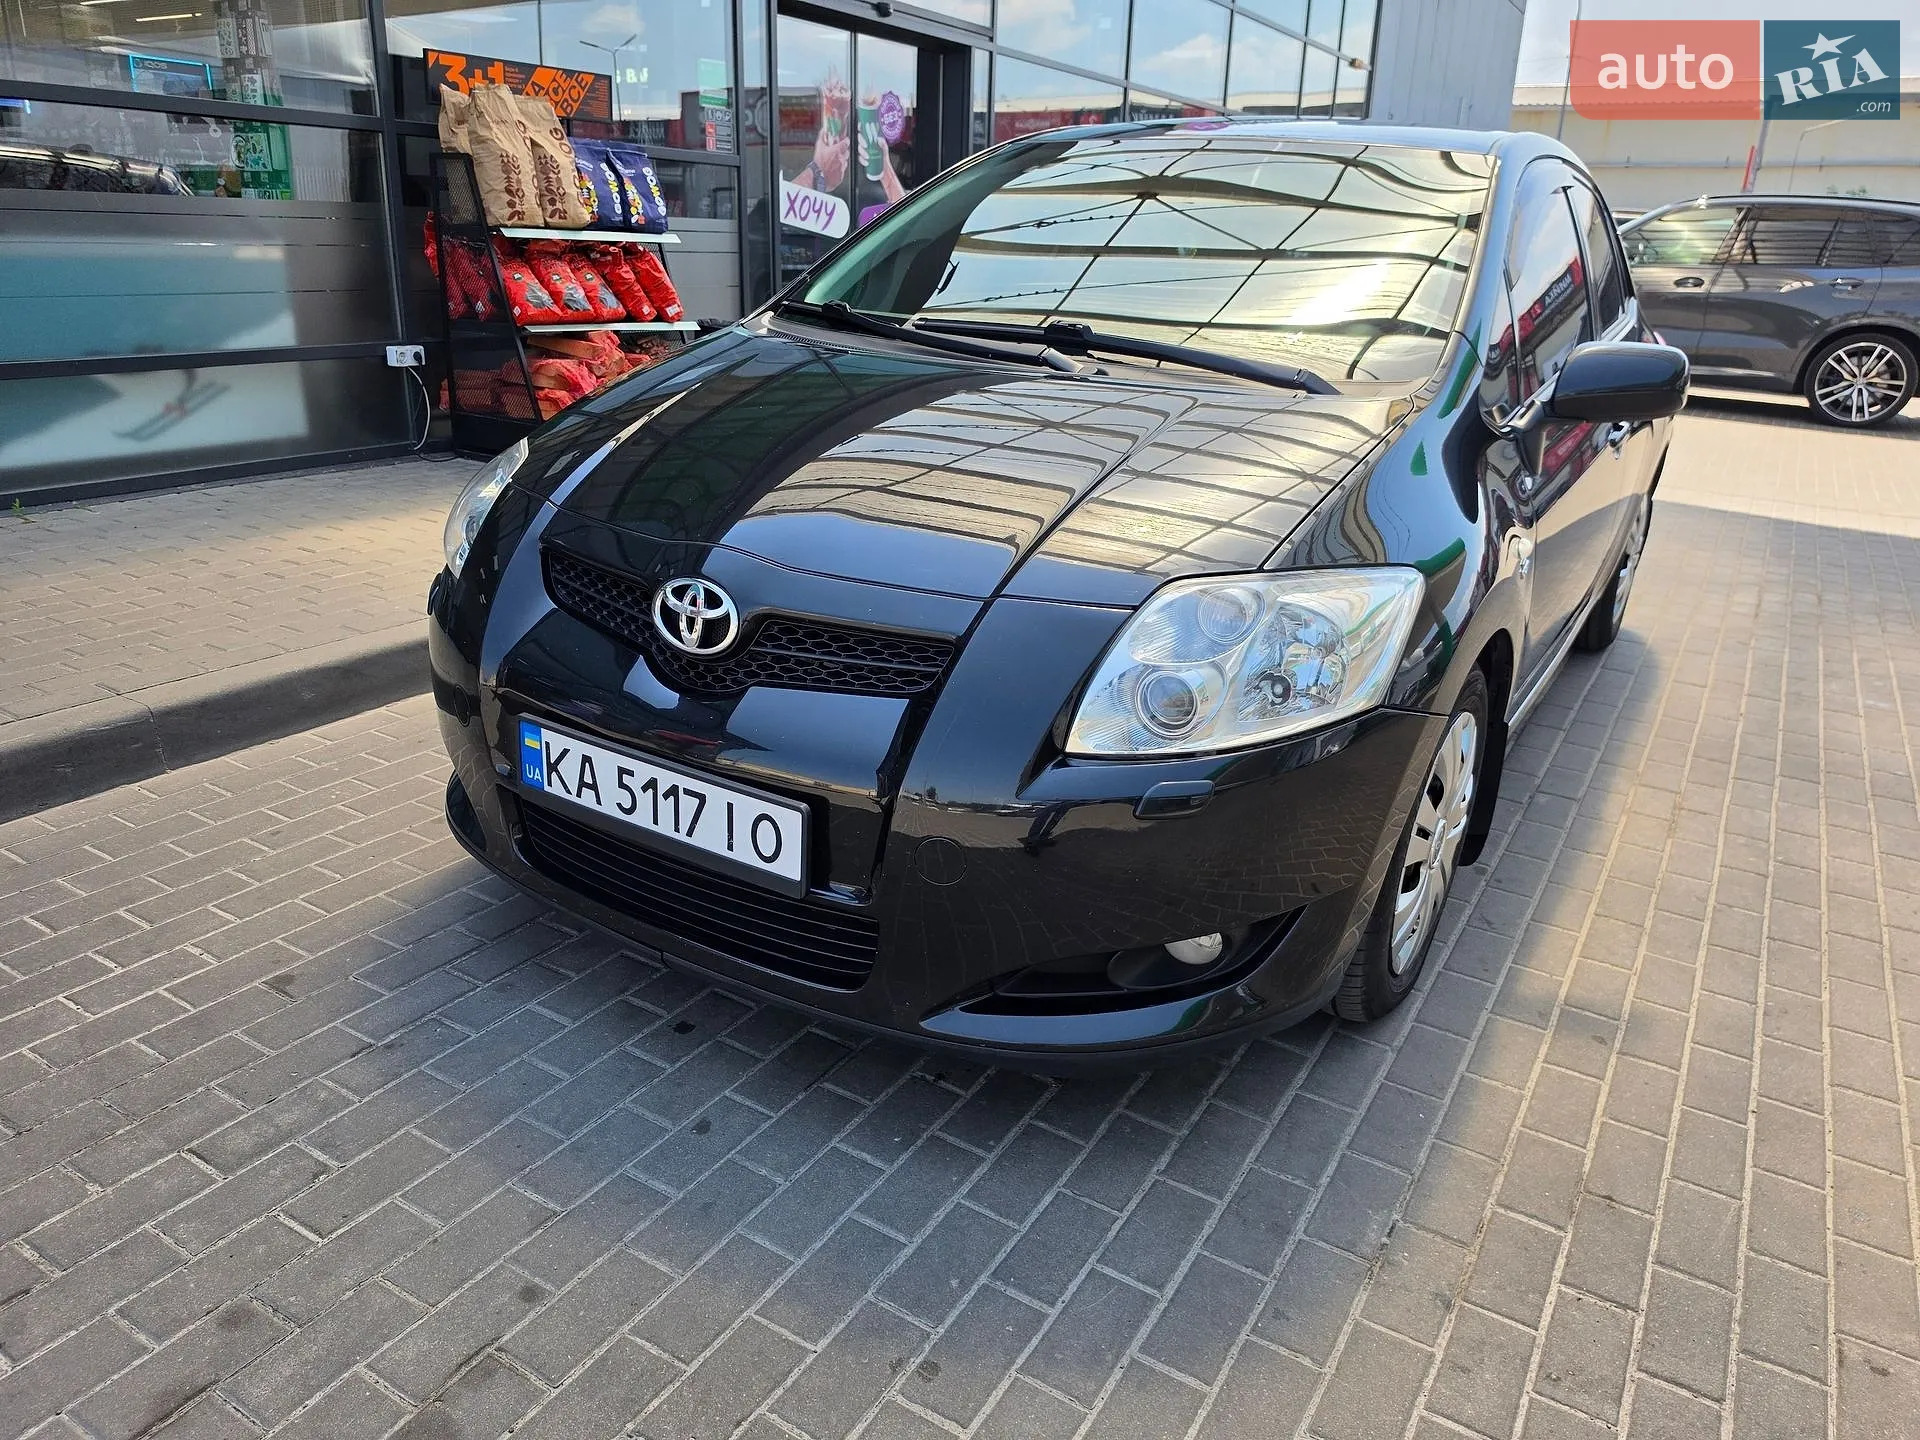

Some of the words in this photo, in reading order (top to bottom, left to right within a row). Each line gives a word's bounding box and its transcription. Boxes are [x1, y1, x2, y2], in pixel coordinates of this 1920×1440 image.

[561, 74, 591, 117] ВСЕ
[784, 190, 836, 232] ХОЧУ
[526, 764, 542, 783] UA
[545, 740, 602, 806] KA
[616, 765, 707, 838] 5117
[726, 800, 782, 864] IO
